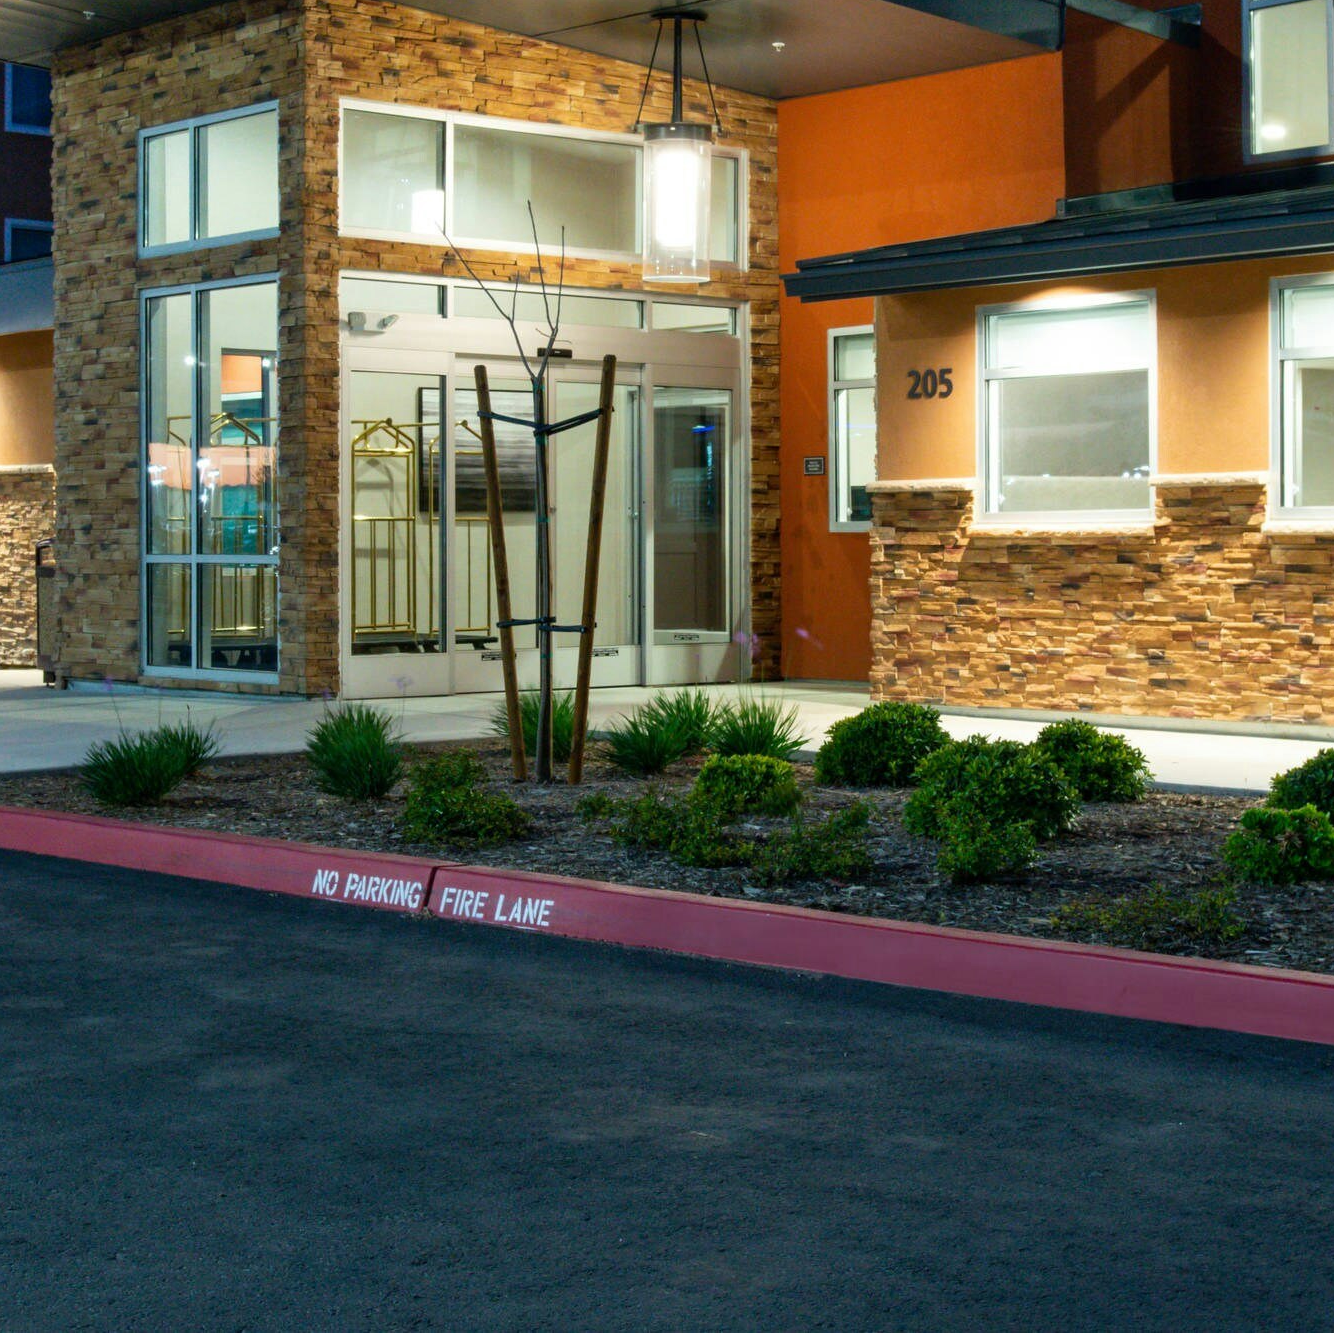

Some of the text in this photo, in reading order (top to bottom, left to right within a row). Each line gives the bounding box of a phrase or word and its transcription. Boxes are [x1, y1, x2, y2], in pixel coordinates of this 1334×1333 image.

[907, 368, 953, 399] 205
[312, 869, 555, 927] NO PARKING FIRE LANE
